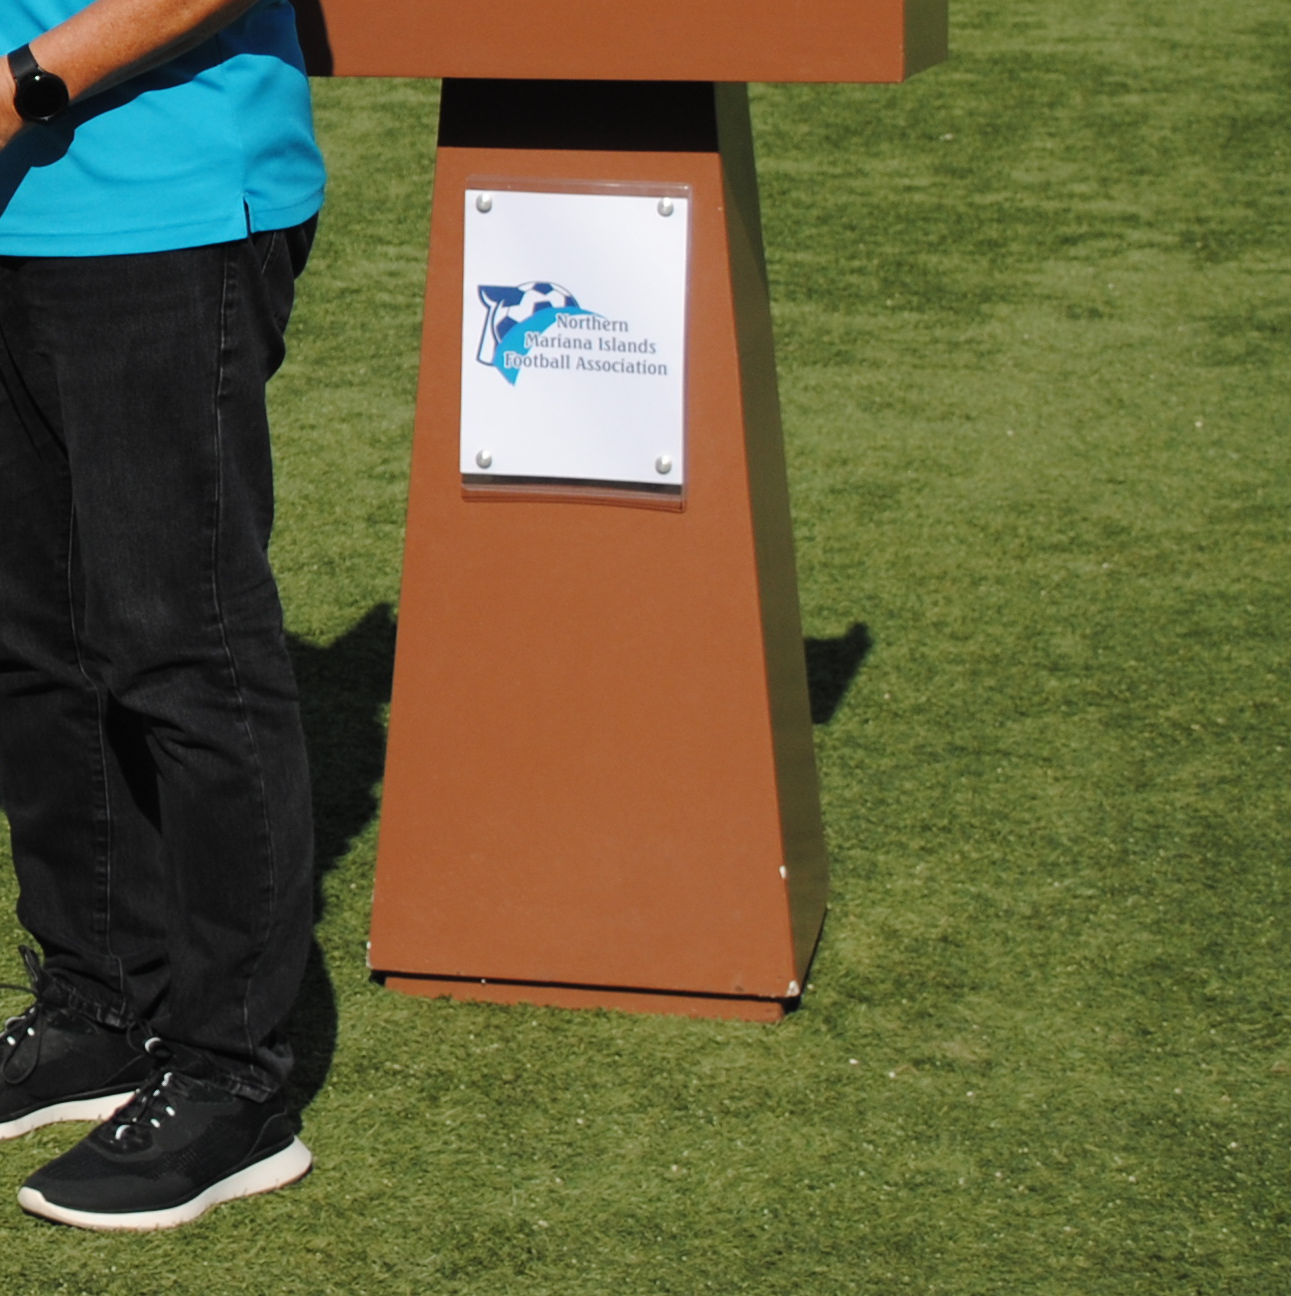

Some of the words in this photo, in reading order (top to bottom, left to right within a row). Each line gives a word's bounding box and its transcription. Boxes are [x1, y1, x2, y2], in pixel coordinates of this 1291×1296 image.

[556, 314, 629, 332] Northern
[525, 333, 593, 350] Mariana
[598, 337, 657, 354] Islands
[505, 353, 570, 370] Football
[576, 356, 668, 376] Association
